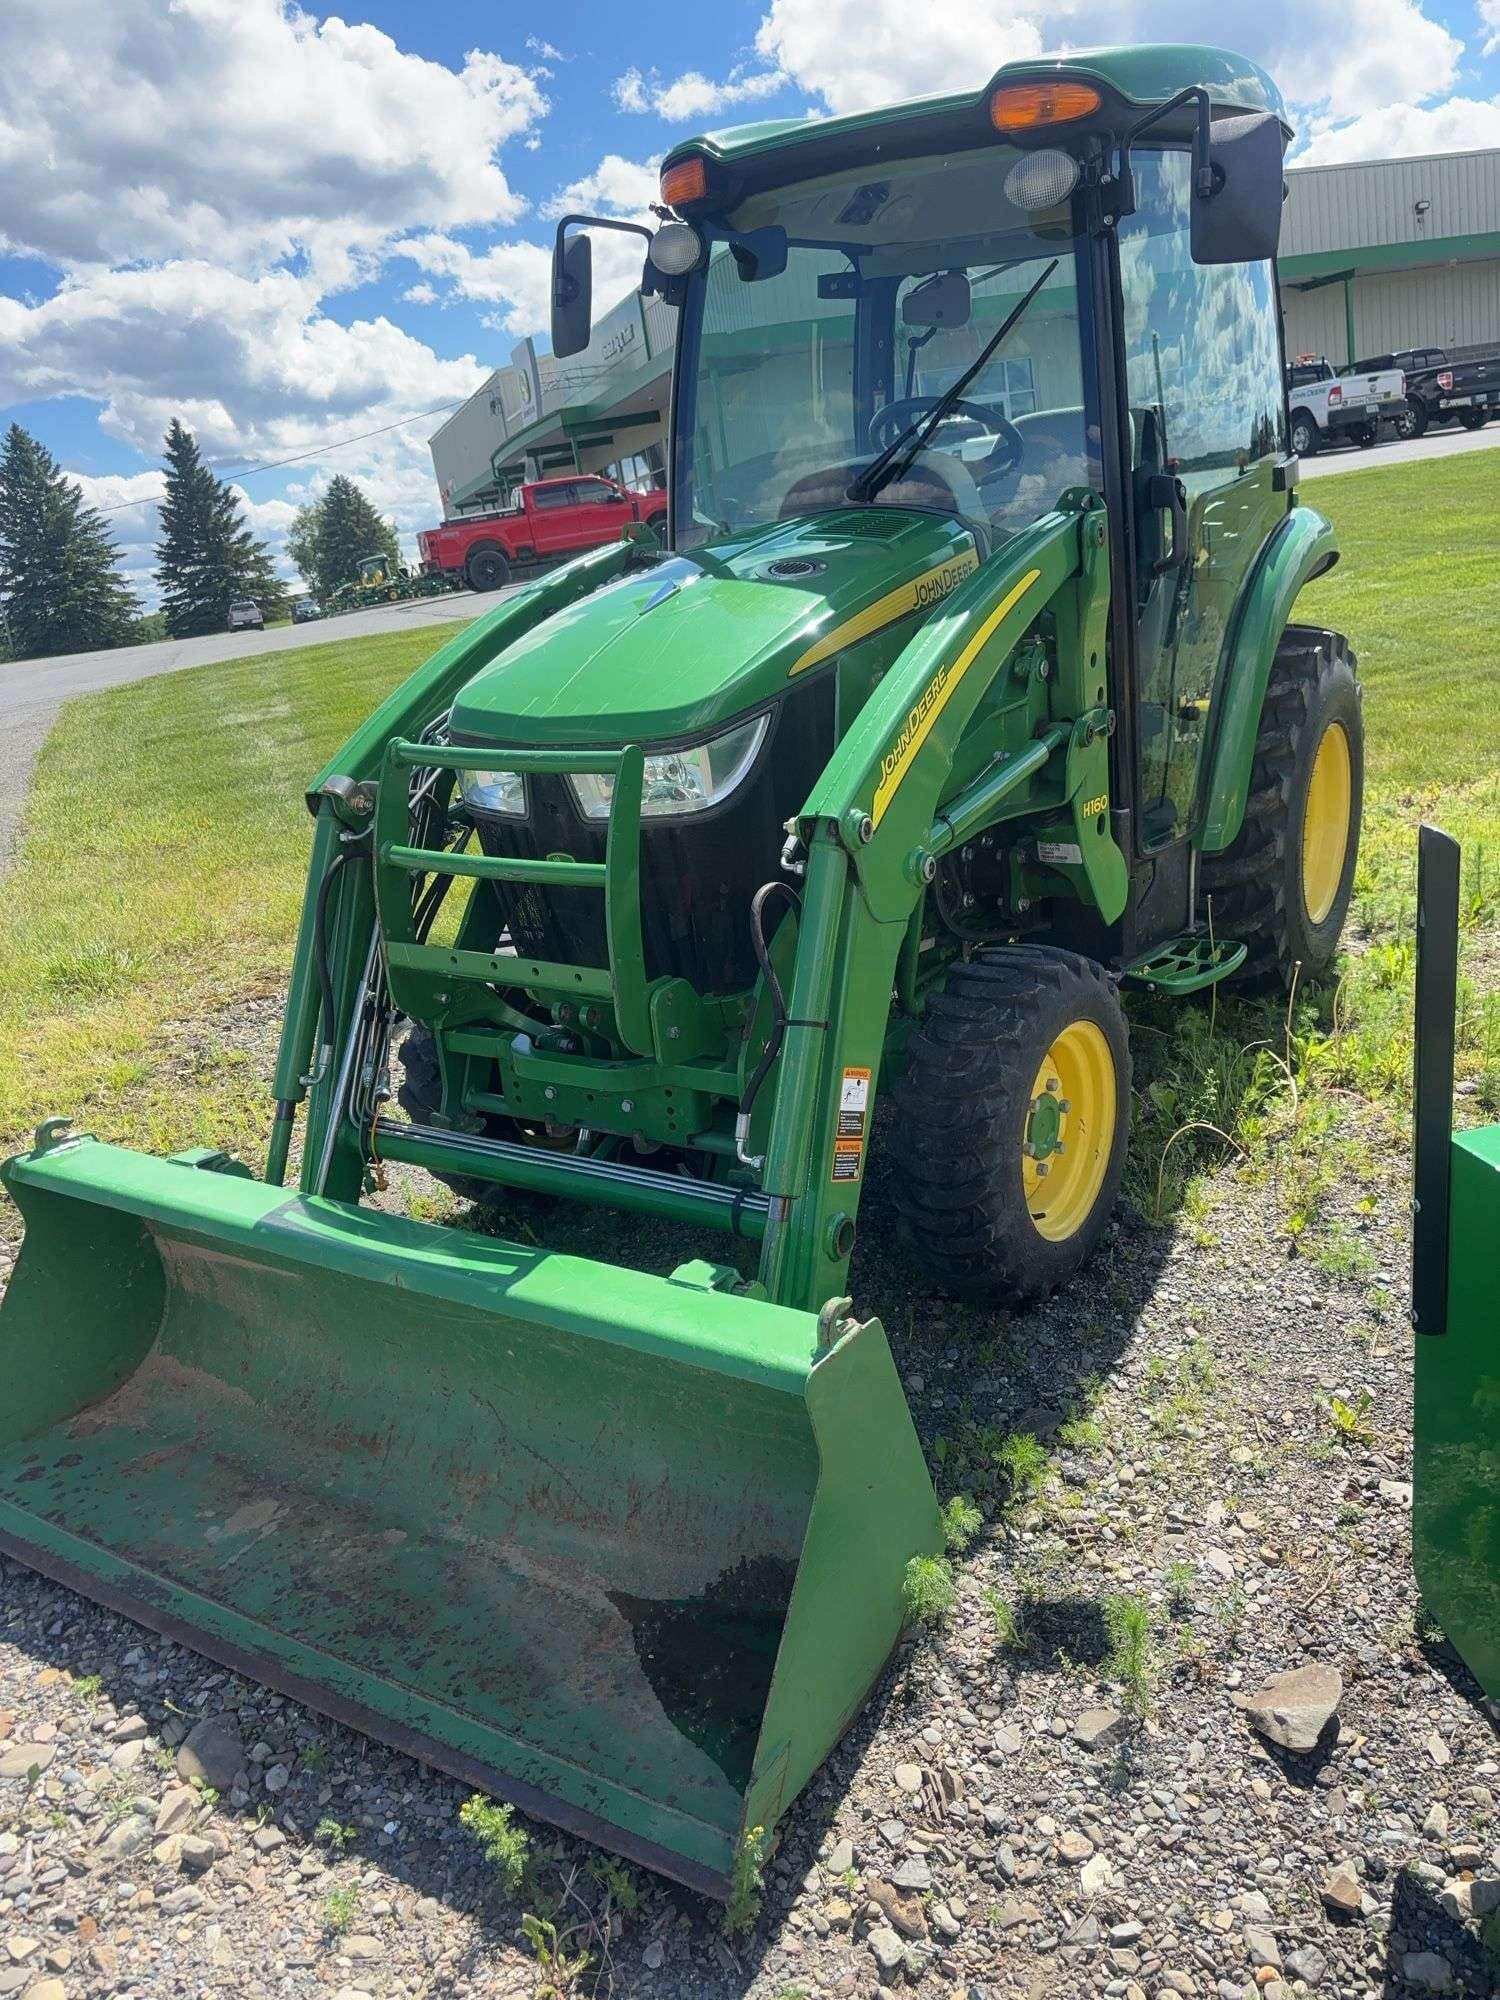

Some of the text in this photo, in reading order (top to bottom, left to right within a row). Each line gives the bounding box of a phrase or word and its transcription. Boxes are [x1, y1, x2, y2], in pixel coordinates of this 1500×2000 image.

[912, 561, 973, 608] JOHN DEERE
[879, 664, 948, 789] JOHN DEERE
[1083, 794, 1109, 819] H160
